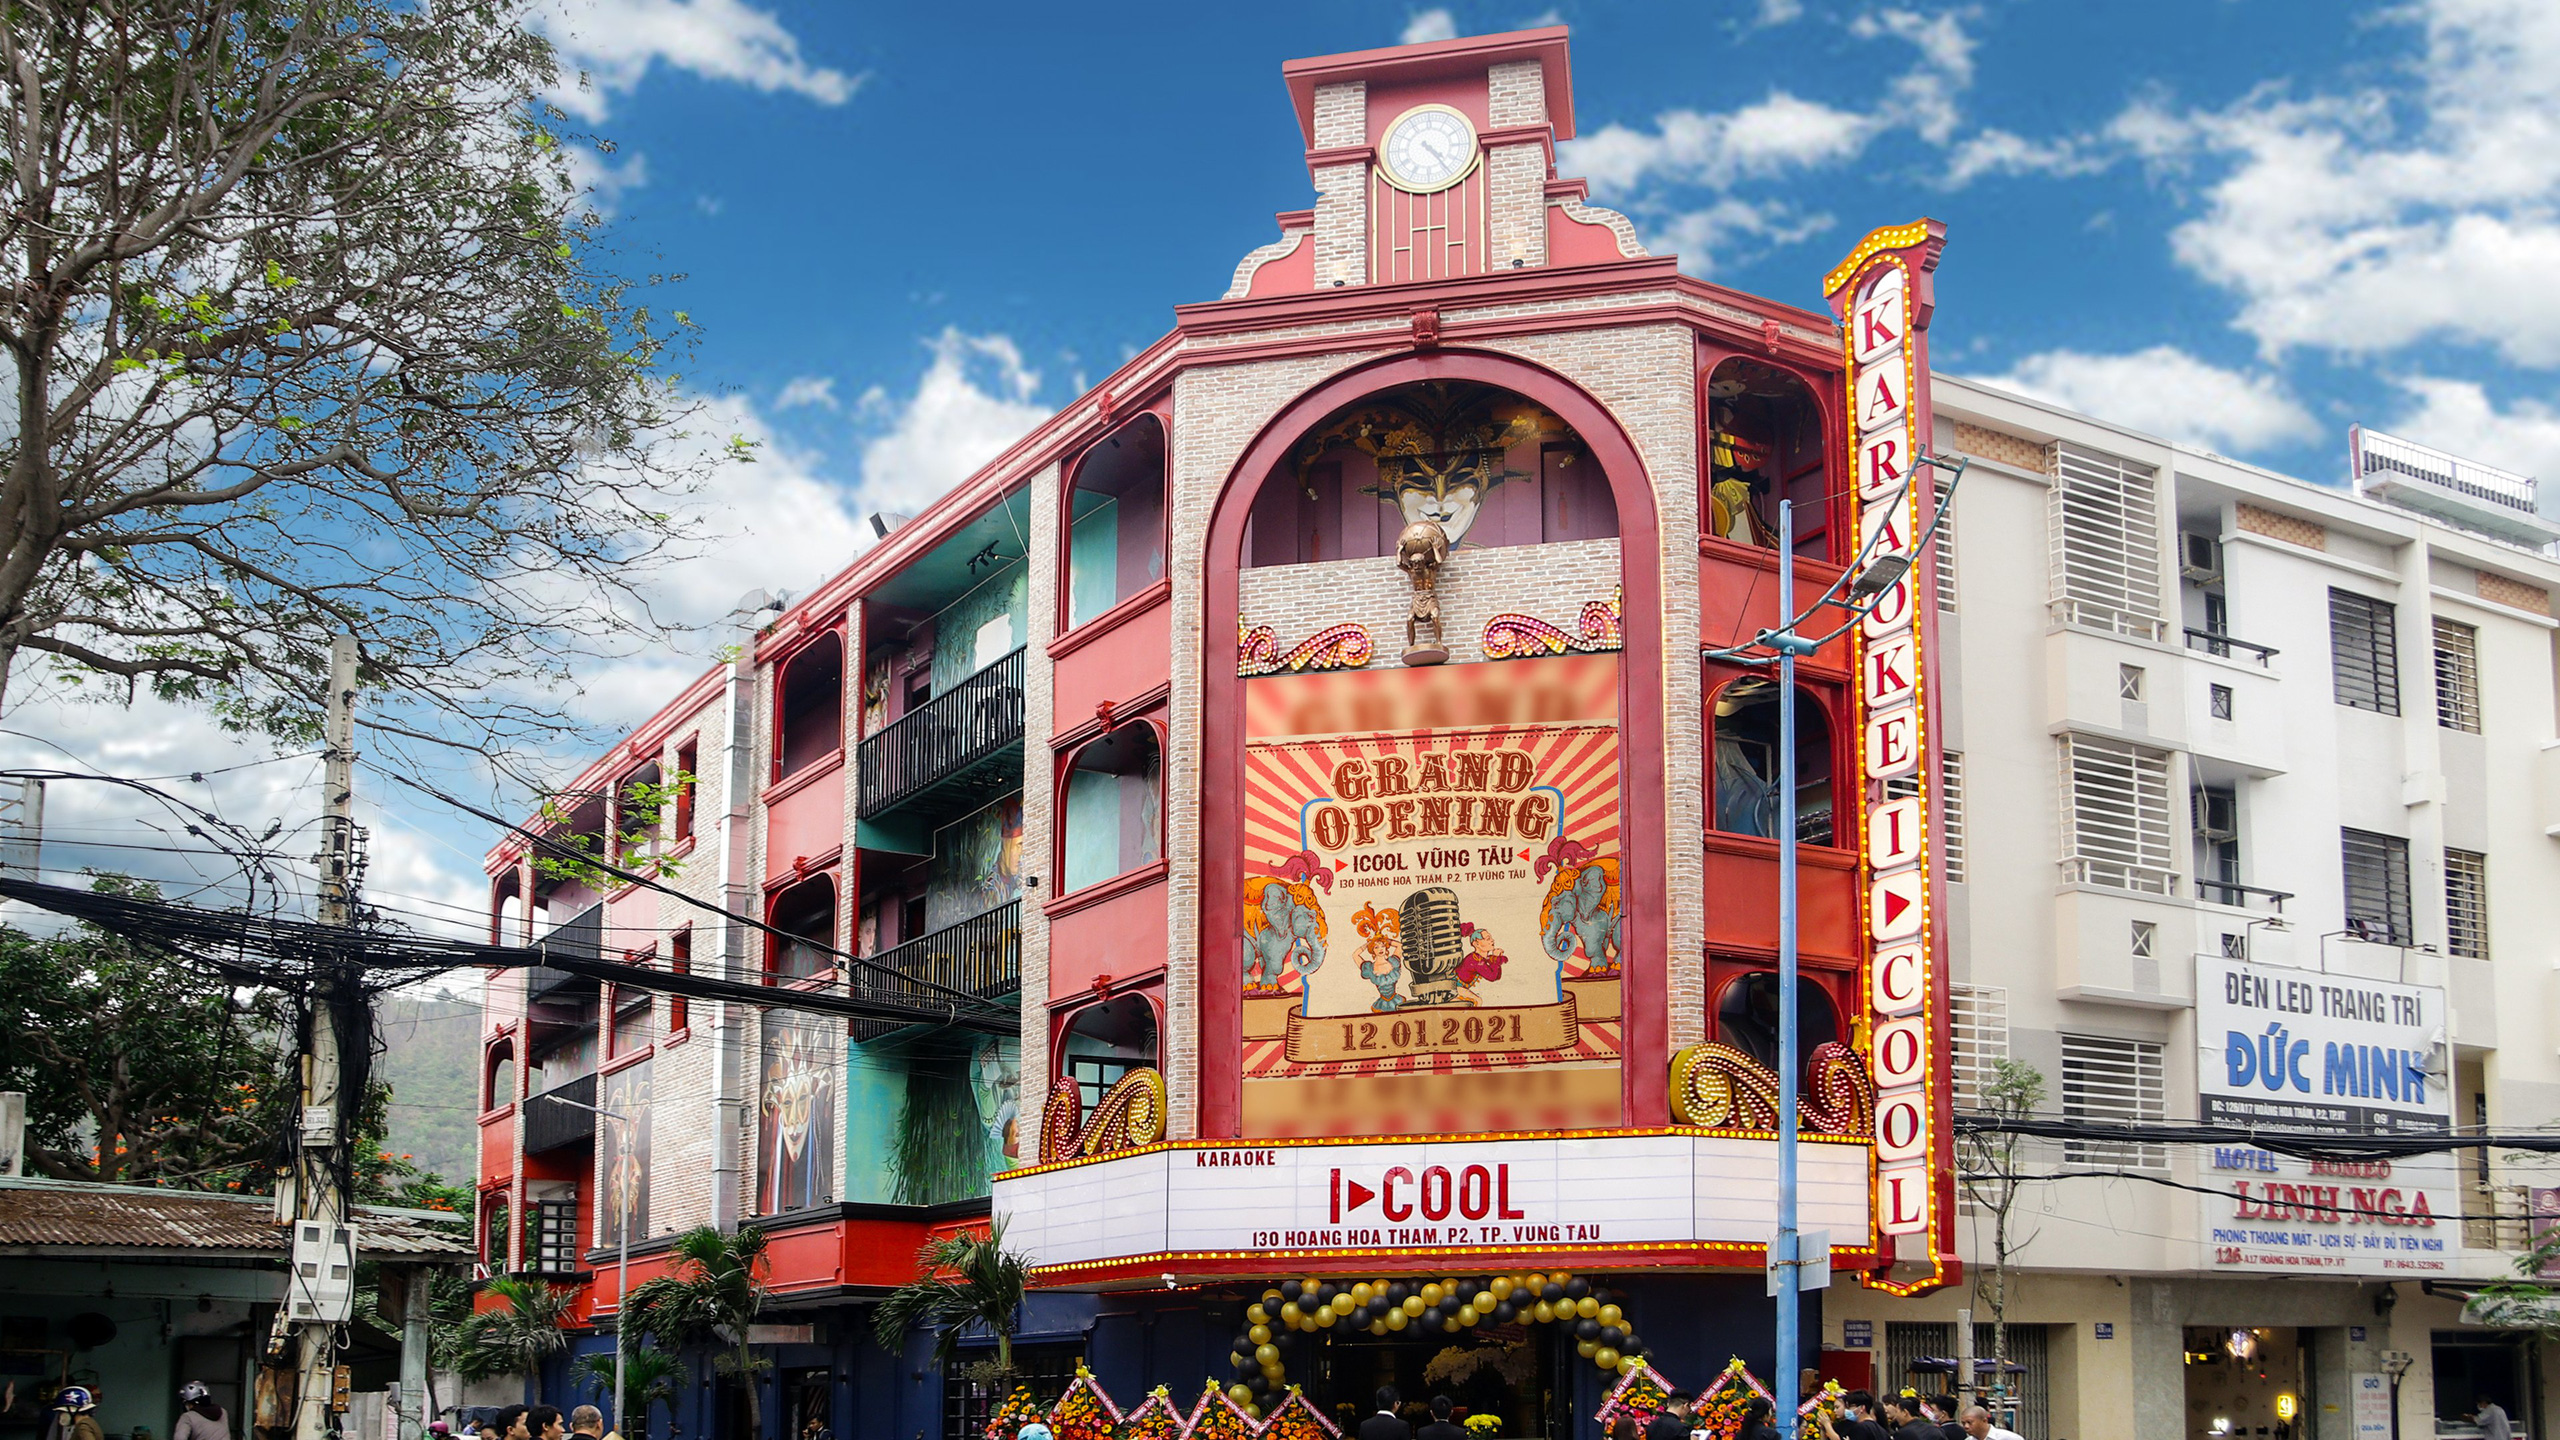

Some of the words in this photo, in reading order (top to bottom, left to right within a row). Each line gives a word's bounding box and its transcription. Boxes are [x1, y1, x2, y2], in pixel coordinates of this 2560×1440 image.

[1859, 298, 1910, 770] KARAOKE
[1333, 751, 1534, 800] GRAND
[1312, 796, 1555, 850] OPENING
[1353, 853, 1408, 873] ICOOL
[1416, 847, 1470, 870] VŨNG
[1339, 879, 1355, 889] 130
[1393, 875, 1412, 886] HOA
[2225, 967, 2269, 1009] ĐÈN
[2276, 979, 2313, 1015] LED
[2320, 985, 2386, 1023] TRANG
[2391, 991, 2422, 1027] TRÍ
[1342, 1013, 1525, 1052] 12.01.2021
[2225, 1021, 2311, 1094] ĐỨC
[2323, 1041, 2427, 1105] MINH
[1196, 1150, 1277, 1168] KARAOKE
[2212, 1147, 2279, 1173] MOTEL
[2307, 1154, 2392, 1180] ROMEO
[2232, 1180, 2342, 1223] LINH
[2347, 1187, 2437, 1227] NGA
[1252, 1231, 1280, 1248] 130
[1284, 1230, 1342, 1247] HOANG
[1347, 1229, 1382, 1246] HOA
[1388, 1228, 1443, 1246] THAM,
[1447, 1227, 1474, 1245] P2,
[1480, 1226, 1507, 1243] TP.
[1513, 1225, 1560, 1242] VUNG
[1566, 1224, 1601, 1241] TAU
[2244, 1255, 2257, 1263] A17
[2286, 1256, 2299, 1265] HOA
